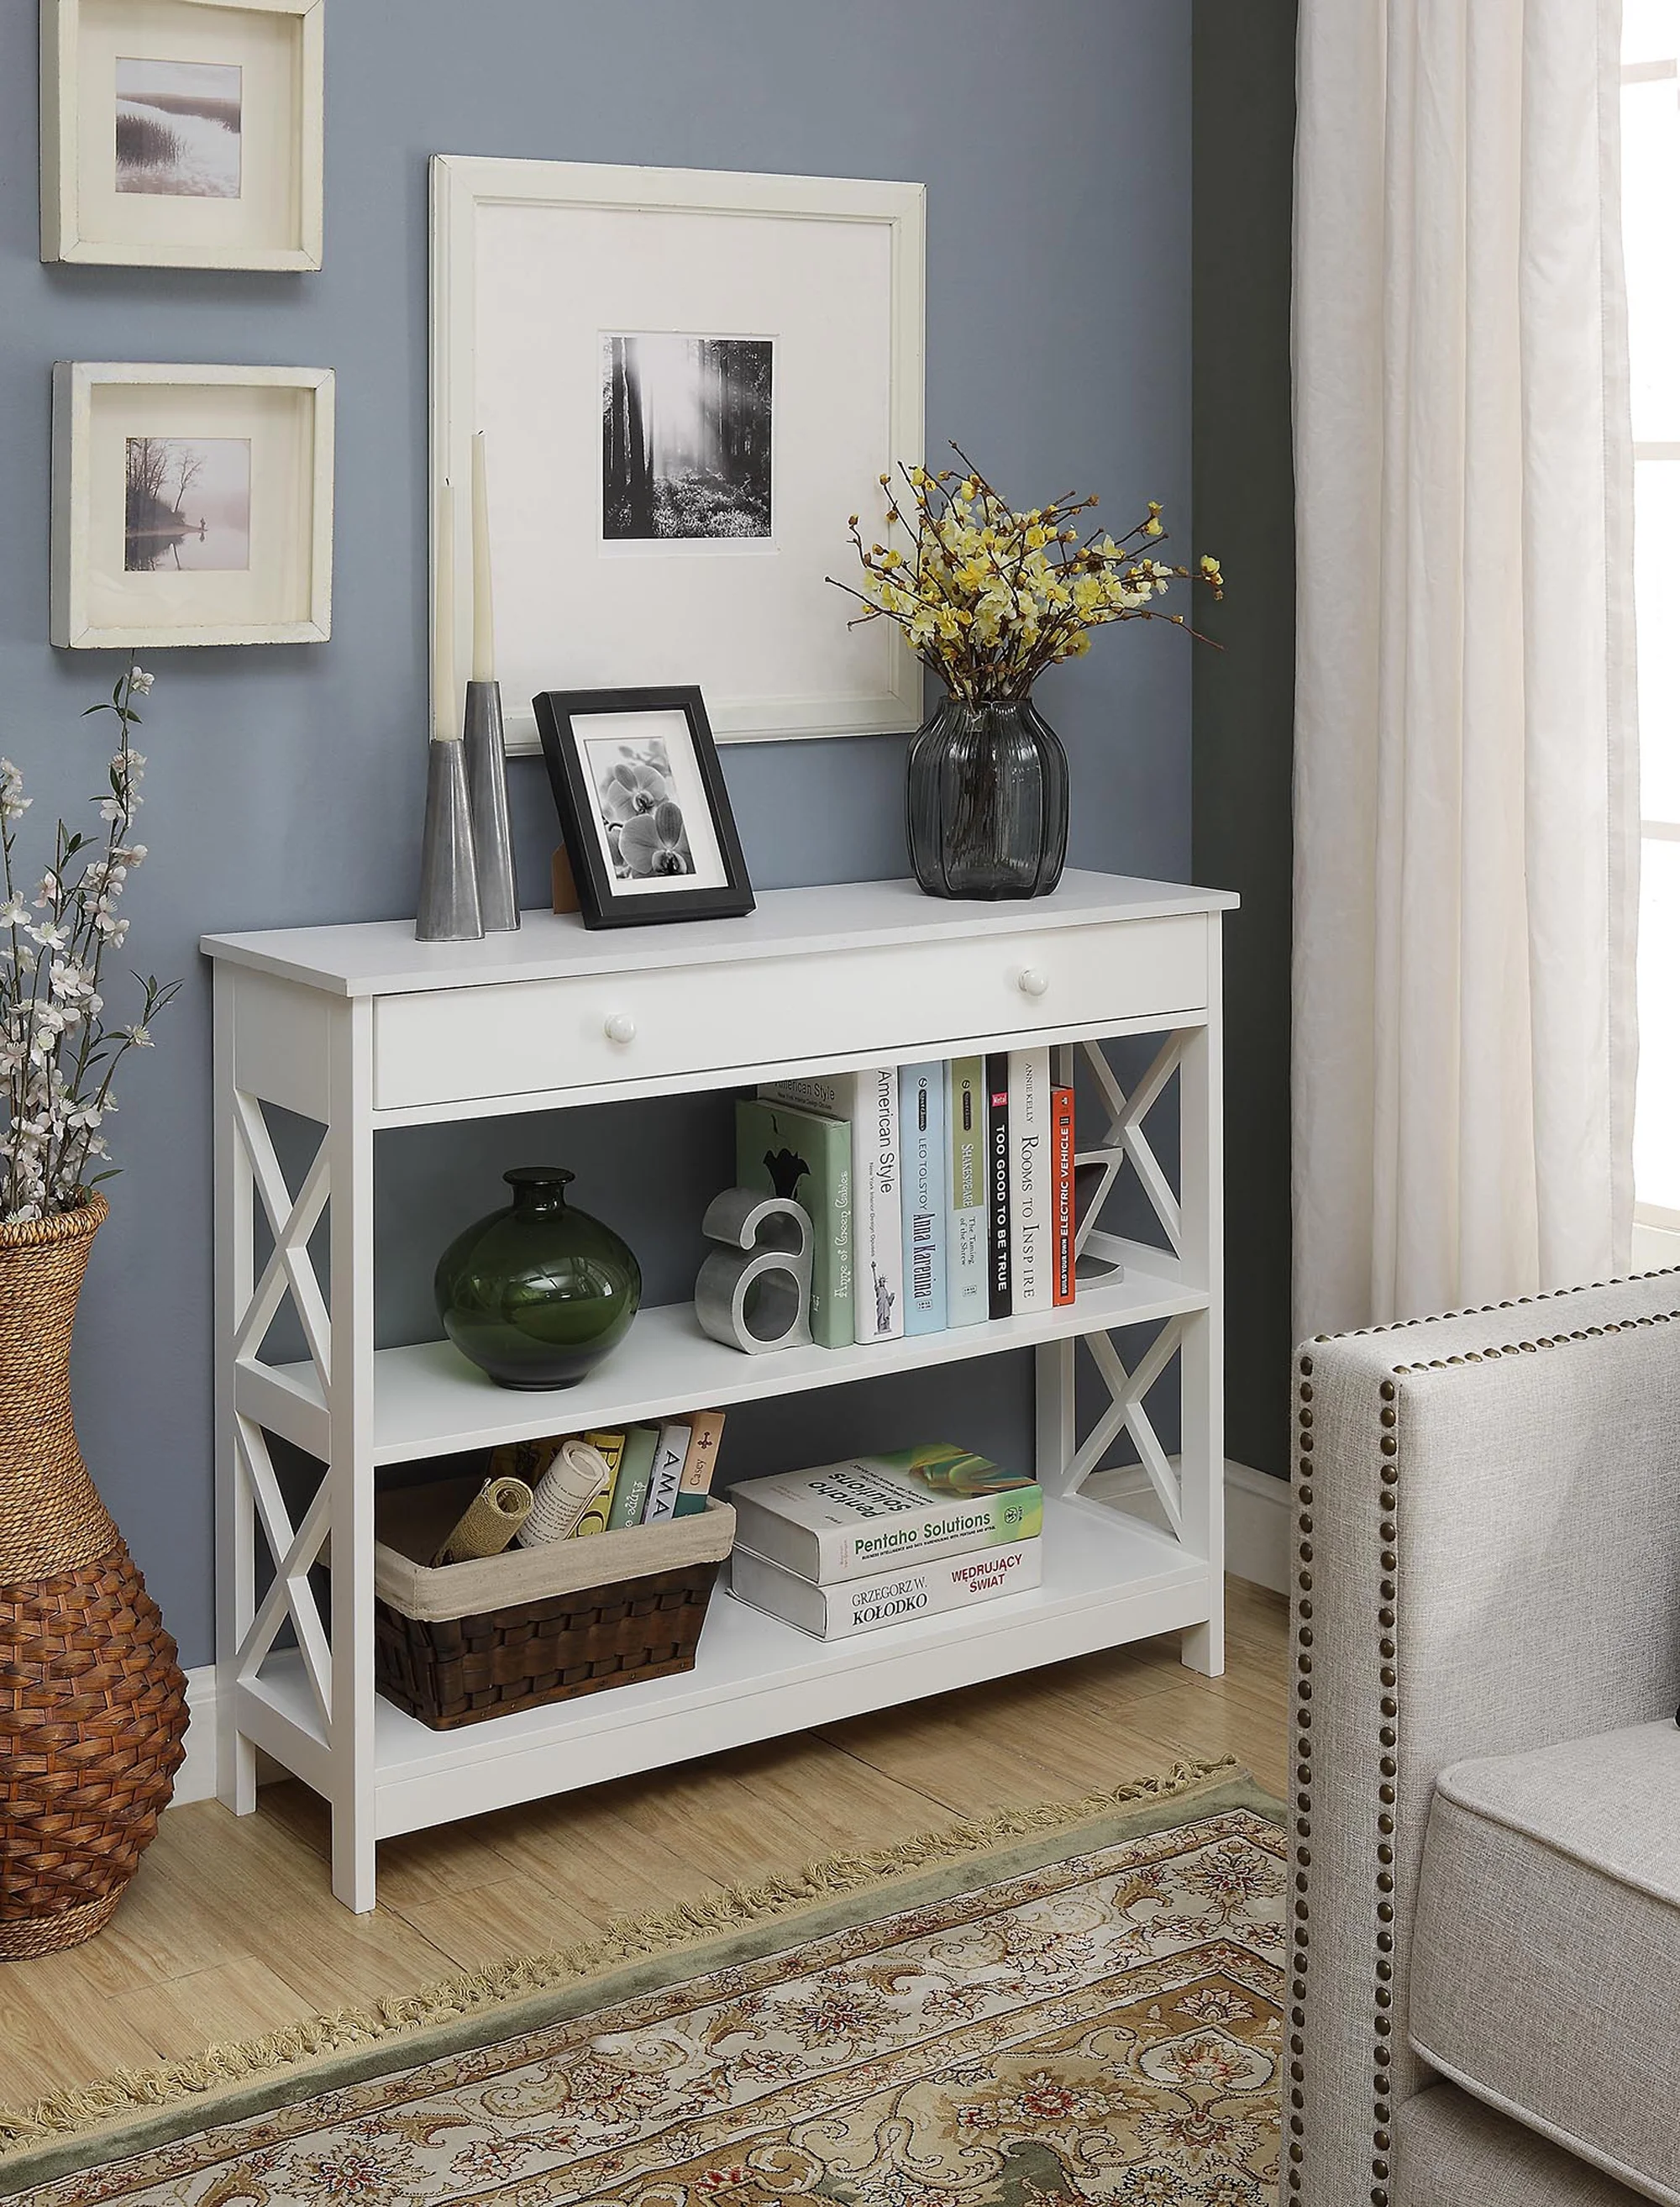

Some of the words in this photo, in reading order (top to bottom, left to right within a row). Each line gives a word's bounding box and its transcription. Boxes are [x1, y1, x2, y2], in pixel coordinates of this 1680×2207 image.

[774, 1080, 812, 1095] merican
[814, 1083, 836, 1101] Style
[1025, 1063, 1033, 1091] ANNIE
[877, 1069, 894, 1148] American
[918, 1138, 927, 1159] LEO
[995, 1124, 1005, 1155] TOO
[1060, 1127, 1069, 1178] VEHICLE
[876, 1152, 895, 1194] Style
[961, 1143, 974, 1207] SHAKESPEARE
[1021, 1134, 1040, 1192] ROOMS
[834, 1170, 848, 1208] Gables
[918, 1161, 927, 1211] TOLSTOY
[996, 1159, 1006, 1201] GOOD
[959, 1217, 968, 1227] of
[997, 1205, 1006, 1226] TO
[1021, 1197, 1034, 1218] TO
[1060, 1181, 1069, 1237] ELECTRIC
[833, 1211, 851, 1246] Green
[912, 1213, 936, 1243] Anna
[959, 1227, 968, 1240] the
[997, 1230, 1007, 1249] BE
[837, 1248, 848, 1262] of
[959, 1241, 968, 1266] Shrew
[968, 1235, 976, 1265] Taming
[833, 1265, 851, 1298] Anne
[912, 1243, 937, 1299] Karenina
[997, 1252, 1007, 1292] TRUE
[653, 1449, 681, 1518] AMA
[690, 1458, 707, 1486] Casey
[625, 1480, 646, 1516] Anne
[807, 1481, 886, 1519] Pentaho
[827, 1472, 912, 1512] Solutions
[855, 1529, 917, 1554] Pentaho
[924, 1513, 990, 1537] Solutions
[951, 1553, 1022, 1582] WĘDRUJĄCY
[969, 1573, 1006, 1594] ŚWIAT
[852, 1578, 913, 1606] GRZEGORZ
[914, 1576, 928, 1590] W.
[852, 1593, 928, 1626] KOŁODKO
